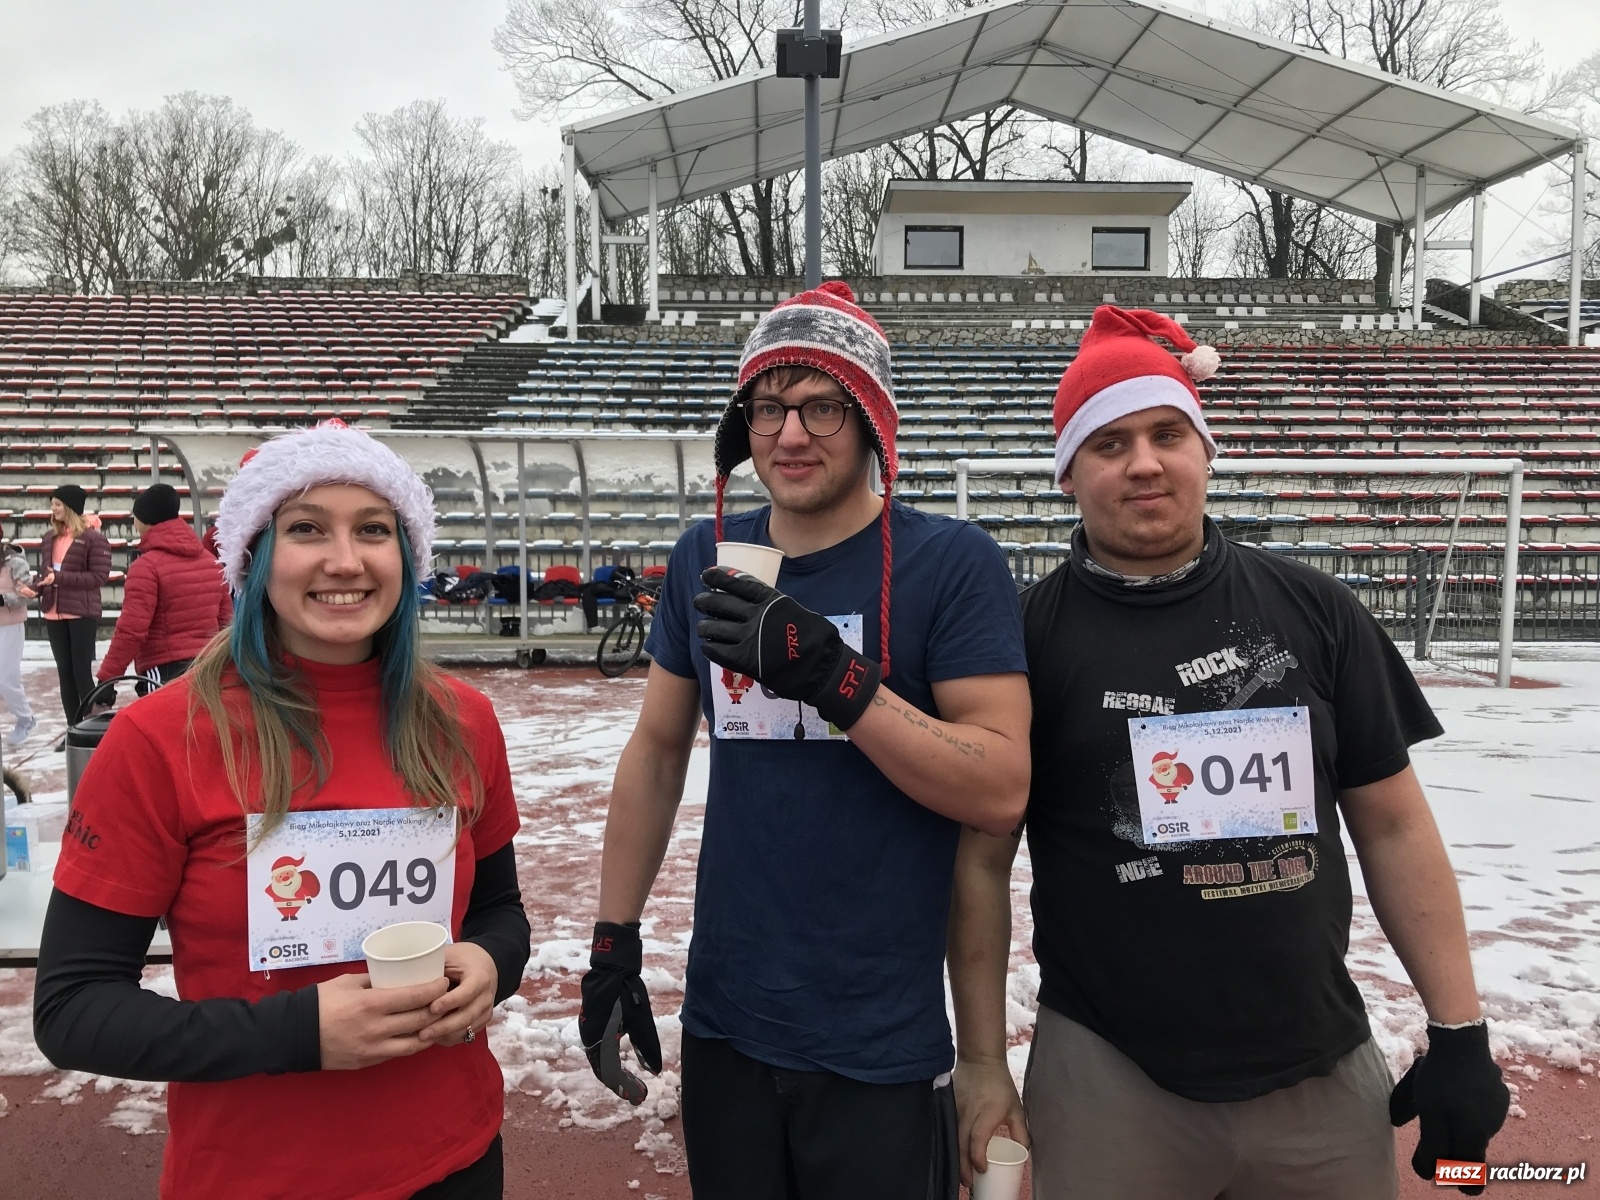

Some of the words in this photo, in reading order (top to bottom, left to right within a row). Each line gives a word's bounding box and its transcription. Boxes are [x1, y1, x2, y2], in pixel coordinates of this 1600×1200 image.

[786, 623, 800, 660] PRO
[1175, 646, 1246, 687] ROCK
[838, 658, 868, 699] SPT
[1102, 690, 1175, 715] REGGAE
[727, 721, 749, 732] OSiR
[1204, 726, 1242, 735] 5.12.2021
[1200, 751, 1292, 796] 041
[308, 820, 354, 829] Mikołajkowy
[396, 818, 423, 826] Walking
[338, 828, 381, 838] 5.12.2021
[1157, 821, 1190, 834] OSiR
[1183, 863, 1245, 884] AROUND
[1247, 860, 1276, 881] THE
[1278, 855, 1308, 878] ROCK
[329, 857, 437, 910] 049
[1203, 887, 1238, 899] FESTIWAL
[1241, 883, 1267, 895] MUZYKI
[268, 943, 309, 959] OSiR
